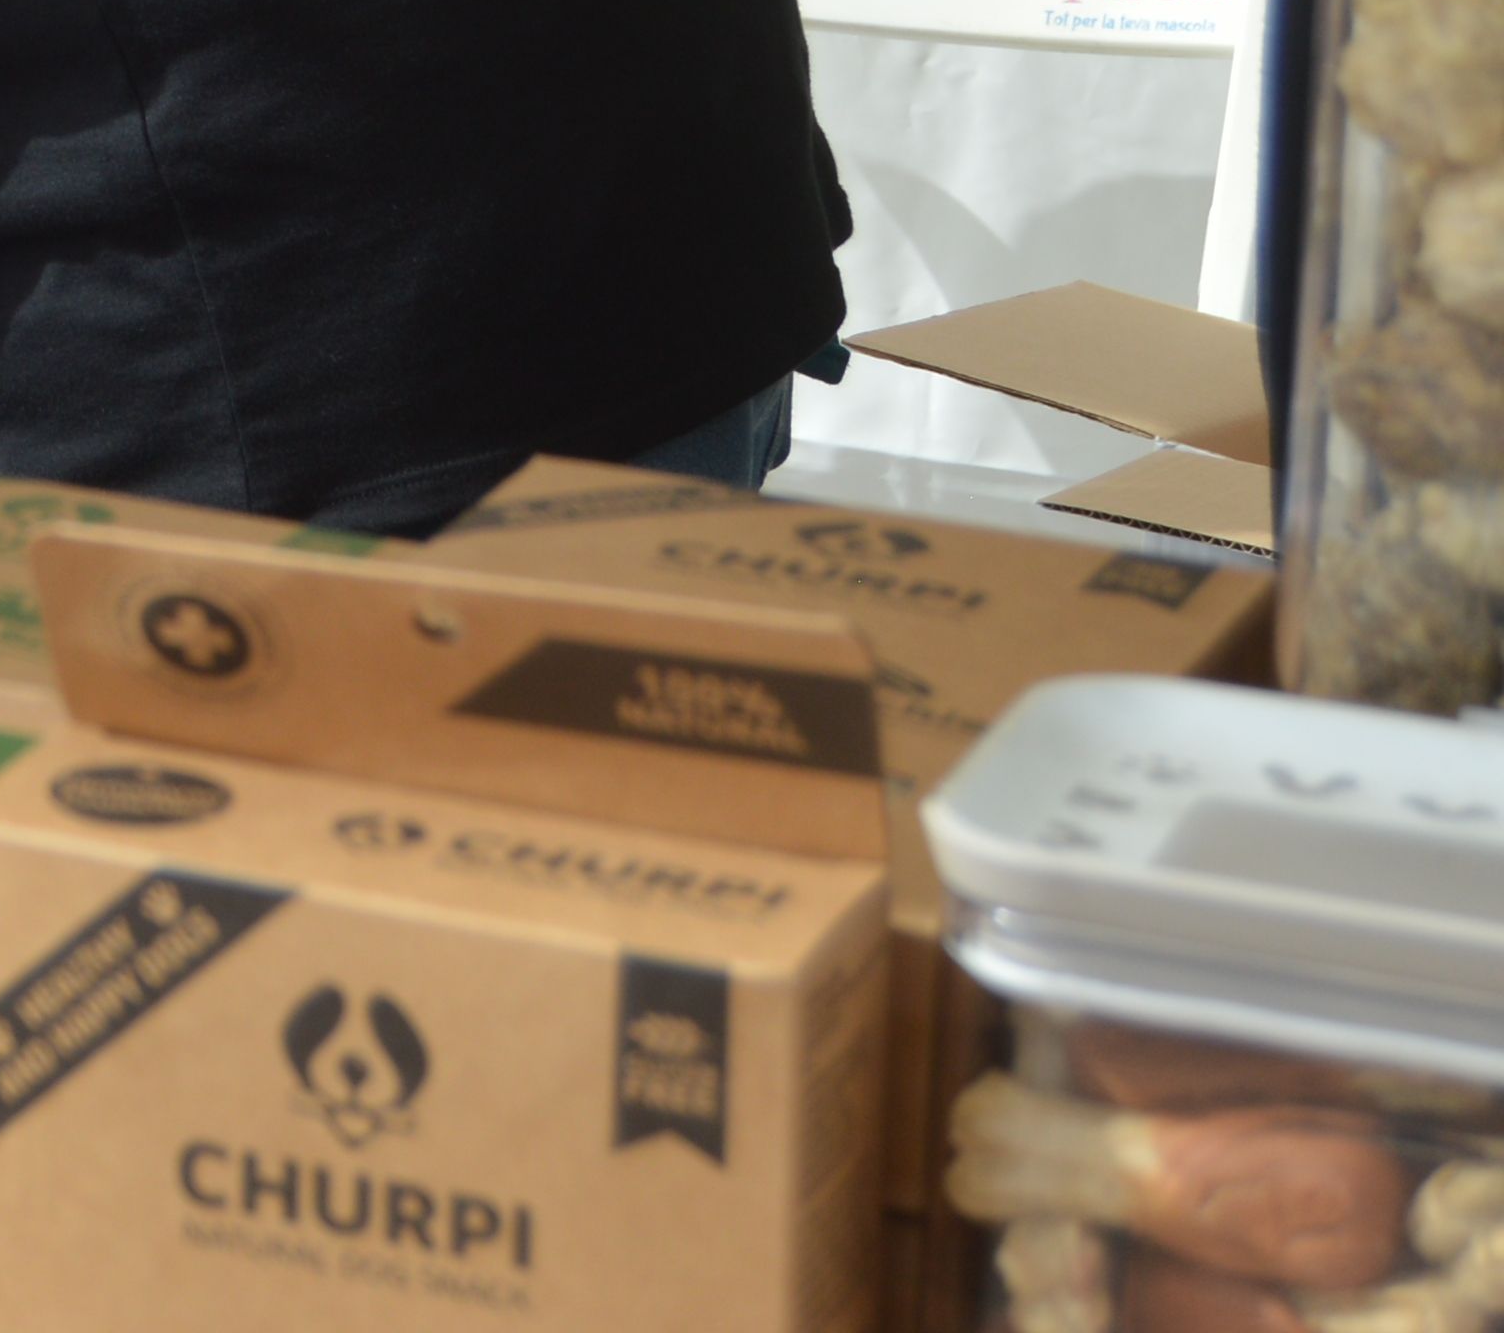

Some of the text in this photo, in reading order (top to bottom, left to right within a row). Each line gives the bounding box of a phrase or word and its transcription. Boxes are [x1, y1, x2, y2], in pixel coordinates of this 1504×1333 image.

[1072, 13, 1098, 32] per
[1101, 12, 1116, 30] la
[446, 828, 796, 918] CHURPI
[16, 912, 139, 1028] HEALTHY
[50, 965, 148, 1055] HAPPY
[136, 901, 223, 995] DOGS
[176, 1136, 535, 1271] CHURPI
[181, 1219, 327, 1276] NATURAL
